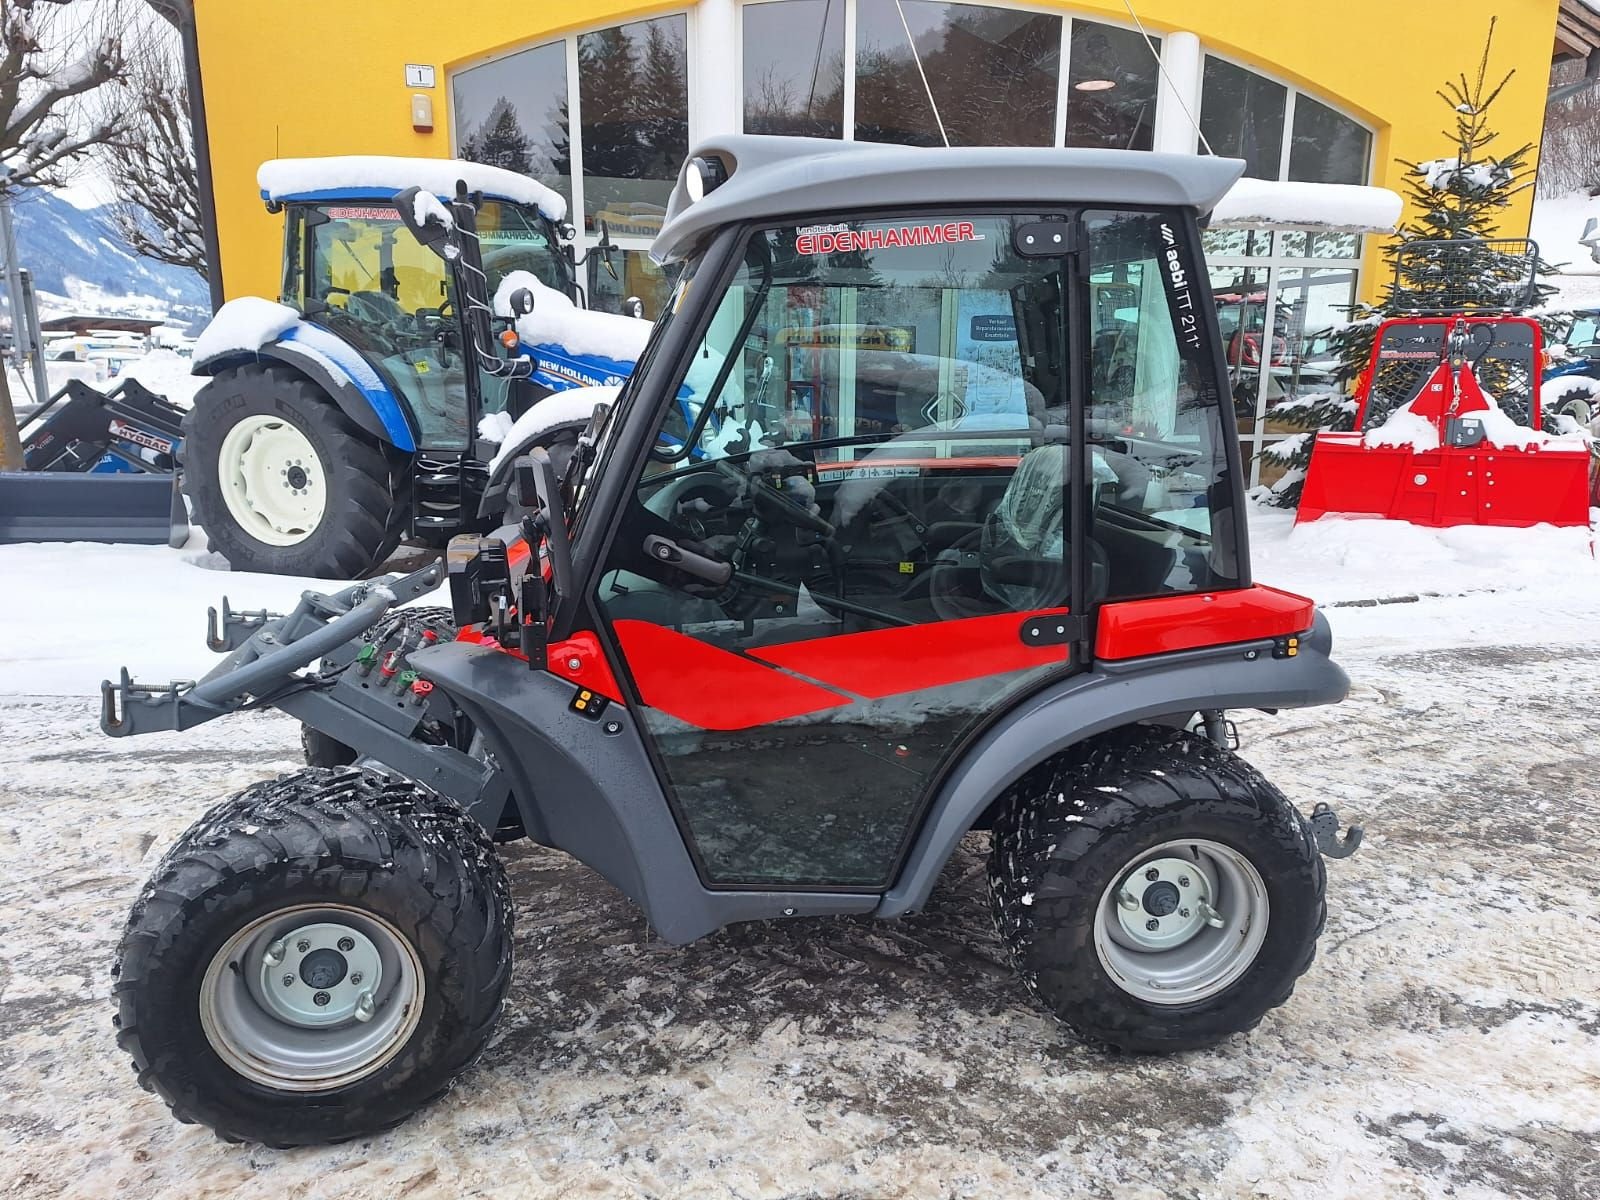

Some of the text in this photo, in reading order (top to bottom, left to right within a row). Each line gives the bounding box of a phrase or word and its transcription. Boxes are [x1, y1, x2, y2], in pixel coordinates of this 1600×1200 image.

[417, 70, 422, 82] 1
[796, 223, 850, 235] Landtechnik
[796, 222, 975, 254] EIDENHAMMER
[1166, 248, 1189, 289] aebi
[1177, 290, 1193, 310] TT
[539, 359, 603, 387] NEW HOLLAND
[119, 428, 169, 452] HYDRAC
